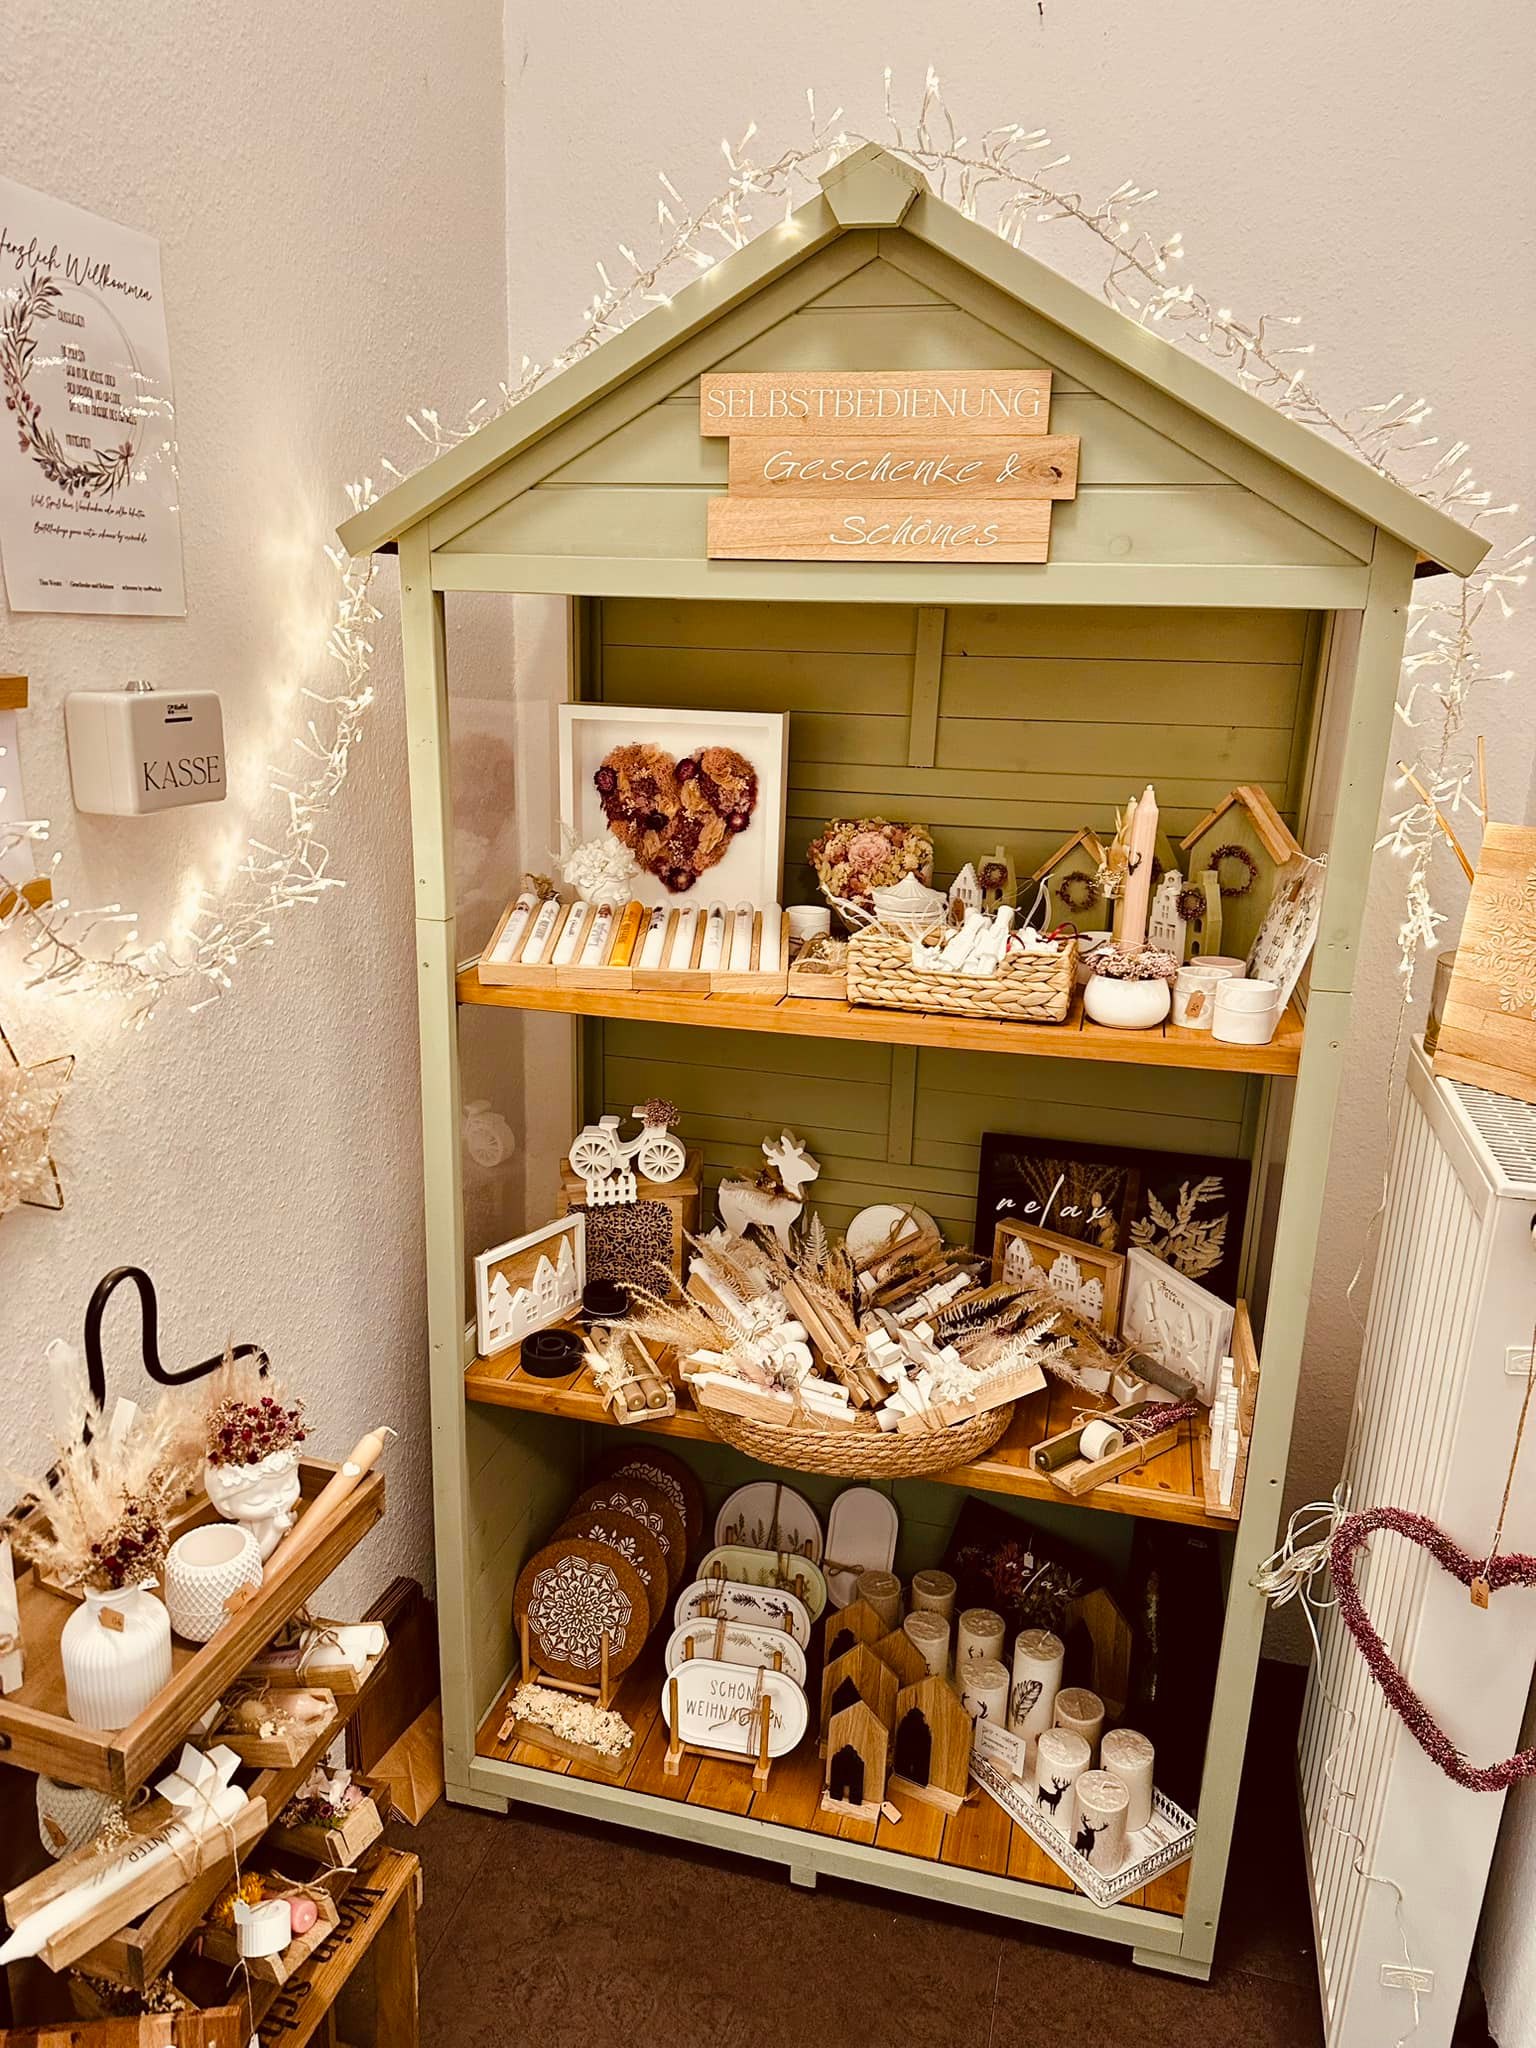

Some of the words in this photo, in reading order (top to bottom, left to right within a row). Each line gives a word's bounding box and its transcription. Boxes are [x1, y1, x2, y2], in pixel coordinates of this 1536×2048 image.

[66, 253, 152, 301] Willkommen
[706, 387, 1041, 419] SELBSTBEDIENUNG
[763, 450, 983, 486] Geschenke
[995, 452, 1023, 484] &
[829, 515, 999, 548] Schönes
[143, 755, 221, 792] KASSE
[995, 1173, 1107, 1228] relax
[1005, 1561, 1069, 1596] relax
